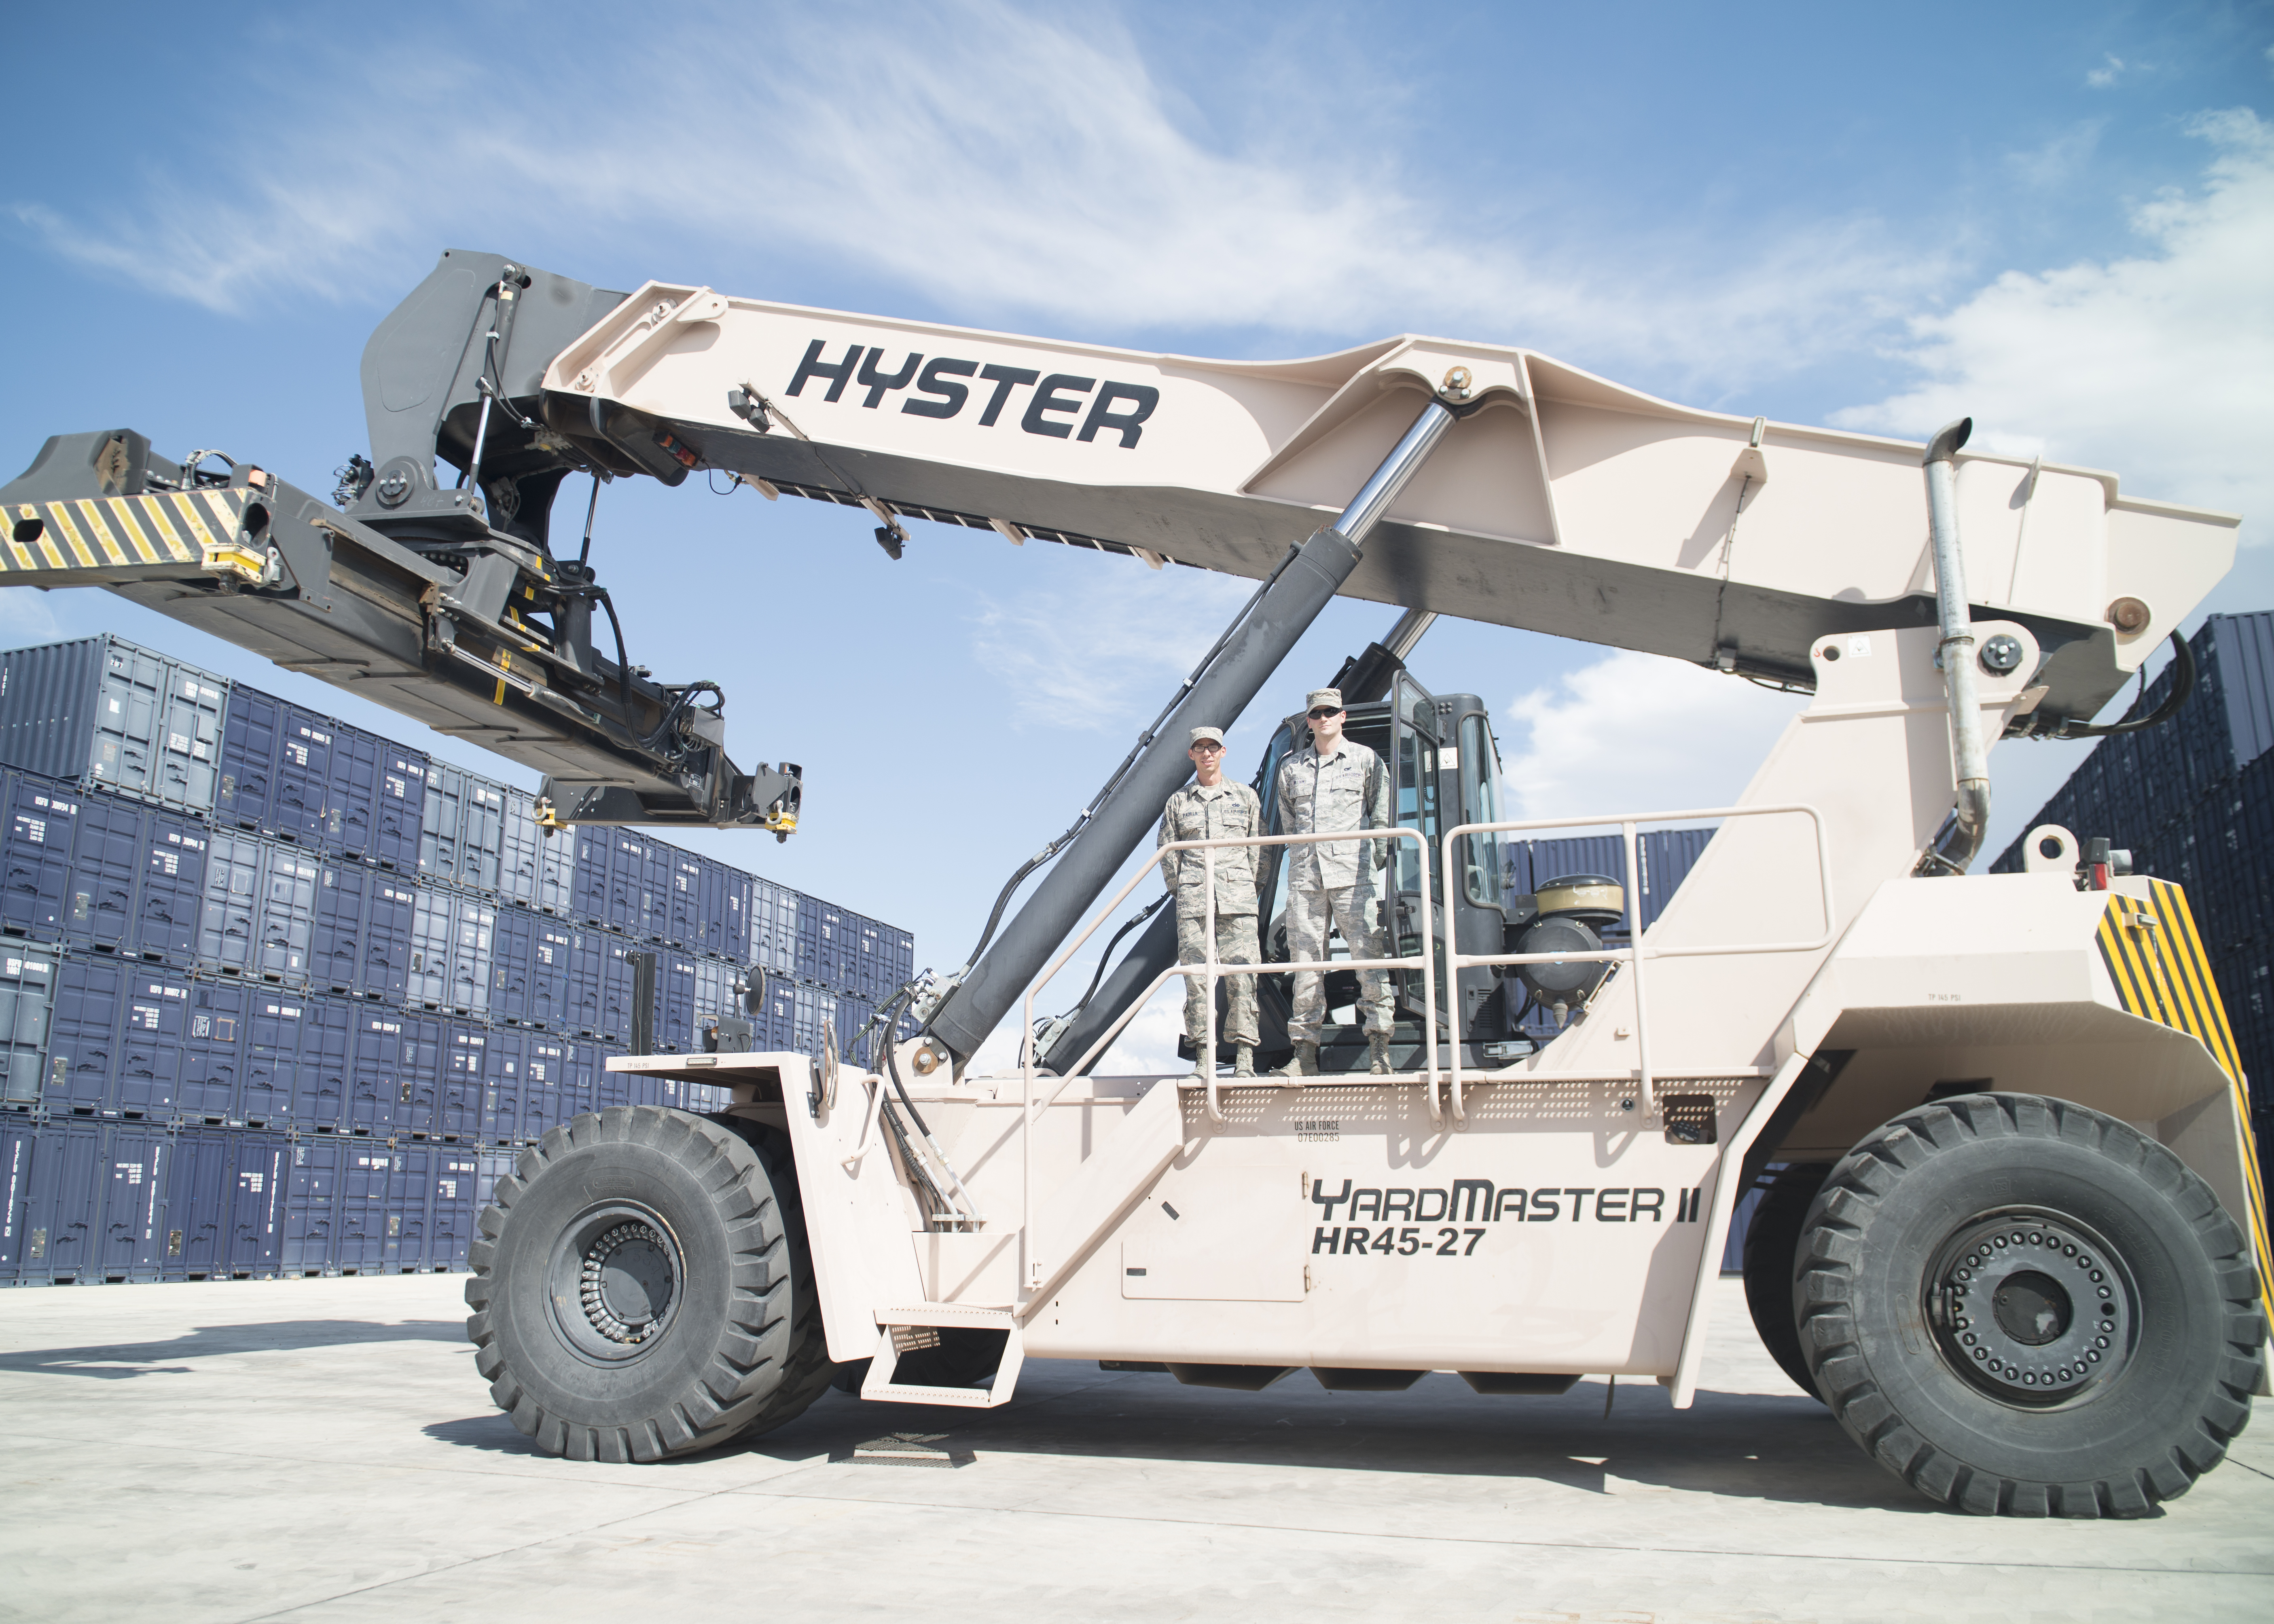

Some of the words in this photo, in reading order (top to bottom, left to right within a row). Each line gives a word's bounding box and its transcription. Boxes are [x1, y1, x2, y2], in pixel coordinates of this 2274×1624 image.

[784, 339, 1160, 450] HYSTER
[35, 796, 48, 807] USFU
[169, 833, 180, 843] USFU
[7, 958, 22, 968] USFU
[24, 961, 43, 971] 01069
[150, 985, 162, 994] USFU
[1294, 1121, 1303, 1131] US
[1305, 1121, 1317, 1131] AIR
[1318, 1120, 1340, 1131] FORCE
[1298, 1132, 1340, 1142] 07E00285
[6, 1174, 16, 1224] 001826
[1677, 1187, 1702, 1223] II
[4, 1226, 11, 1237] 2
[1312, 1227, 1486, 1256] HR45-27
[2104, 1207, 2176, 1380] BRIDGESTONE
